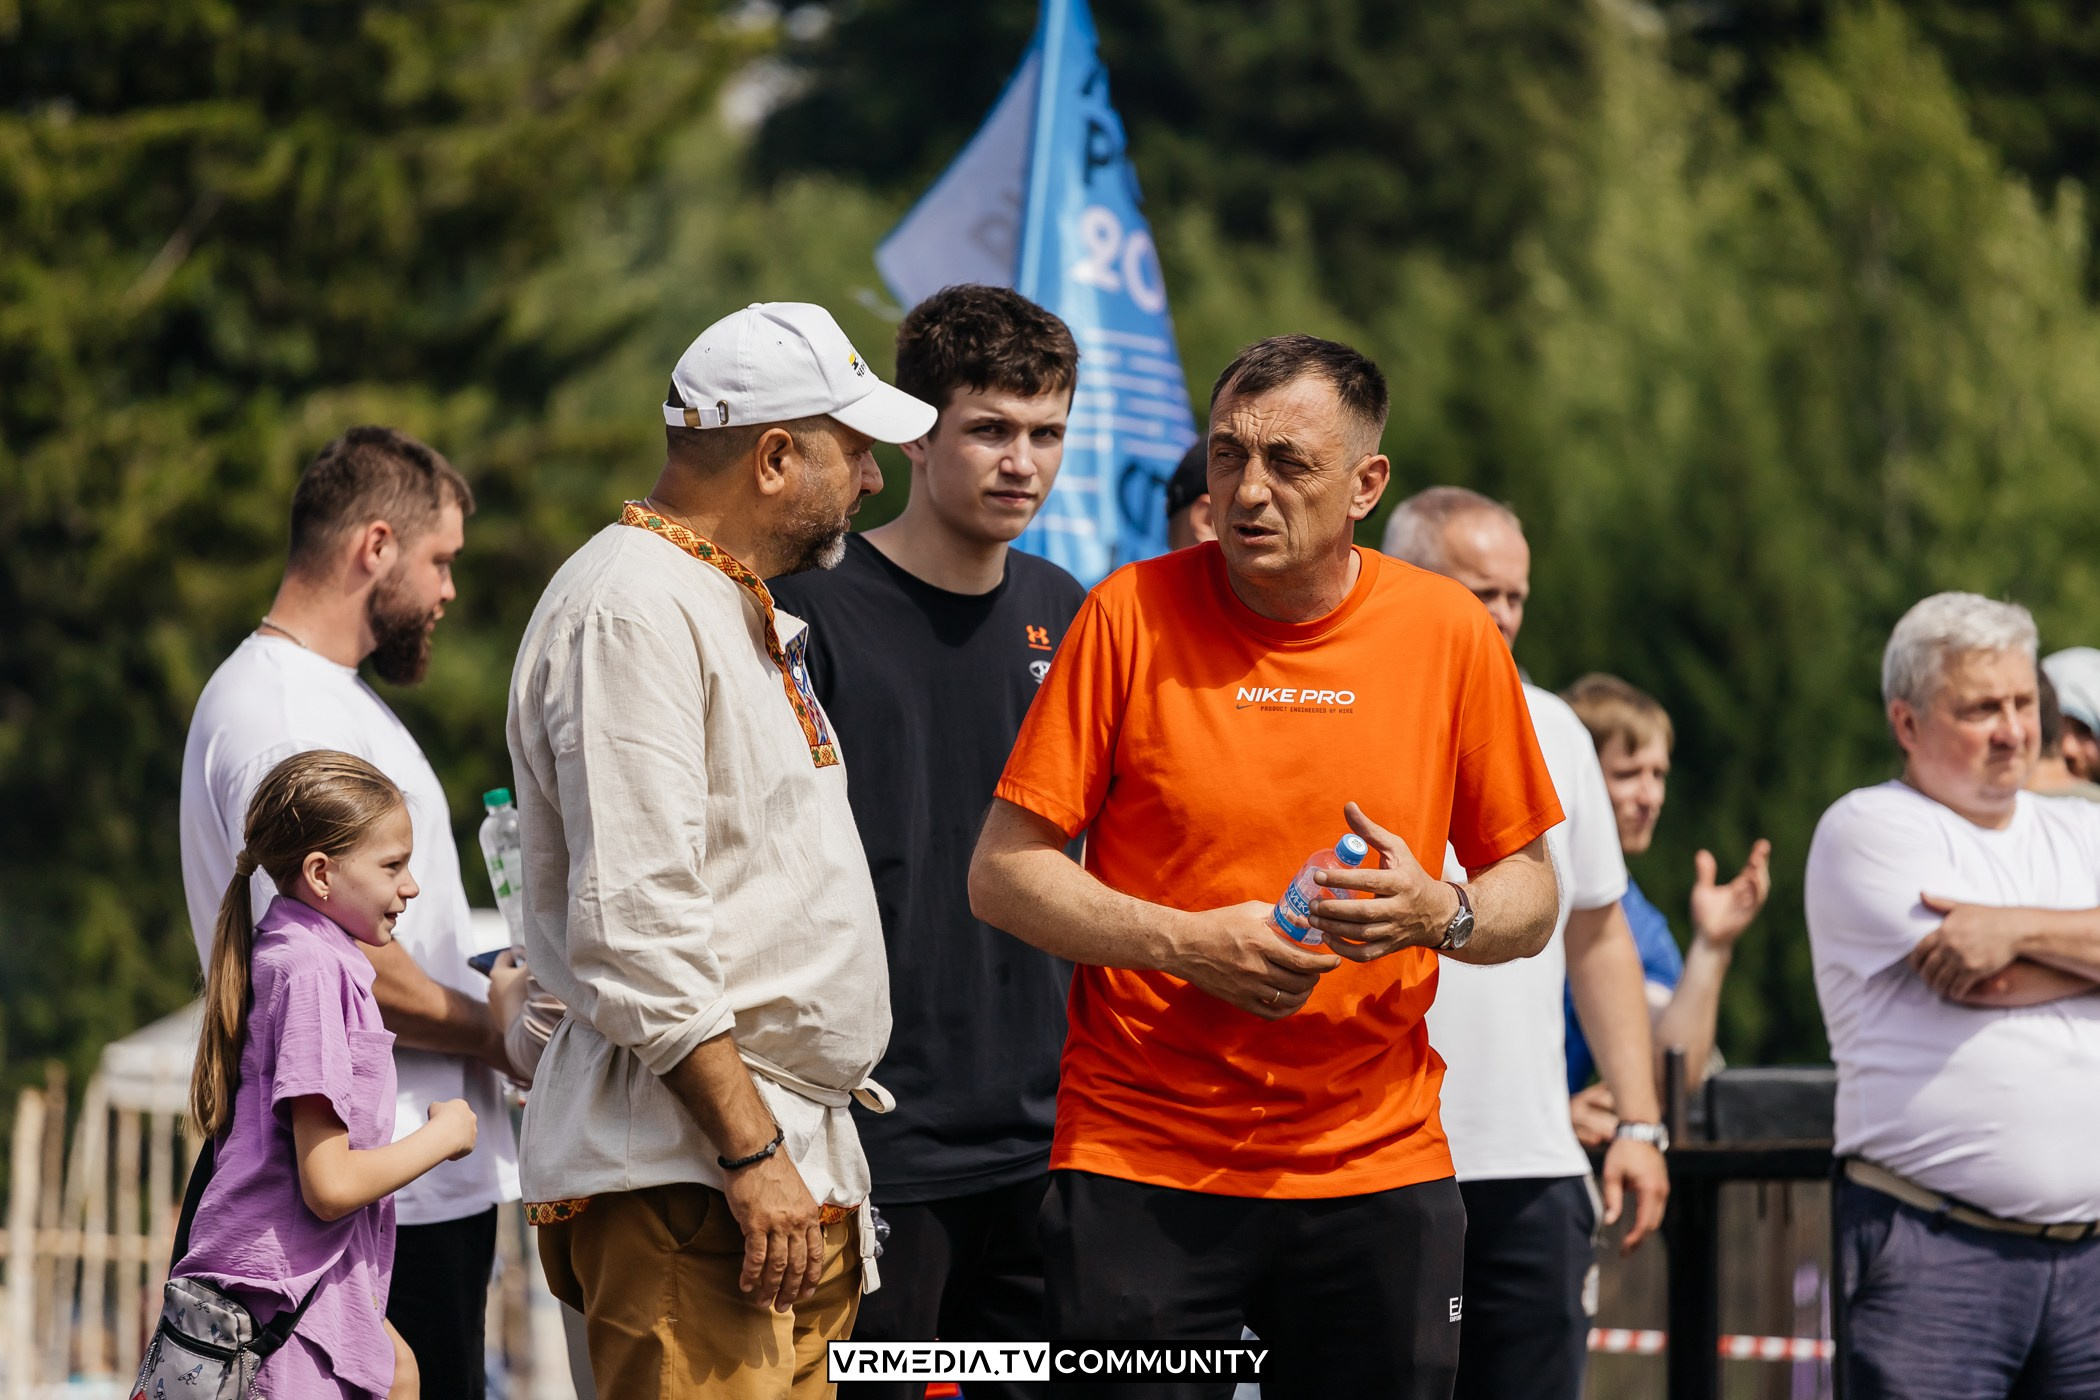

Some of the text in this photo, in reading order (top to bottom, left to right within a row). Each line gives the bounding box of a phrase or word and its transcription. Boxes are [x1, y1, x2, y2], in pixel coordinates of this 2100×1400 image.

[1236, 687, 1356, 705] NIKE PRO
[1290, 706, 1327, 714] ENGINEERED
